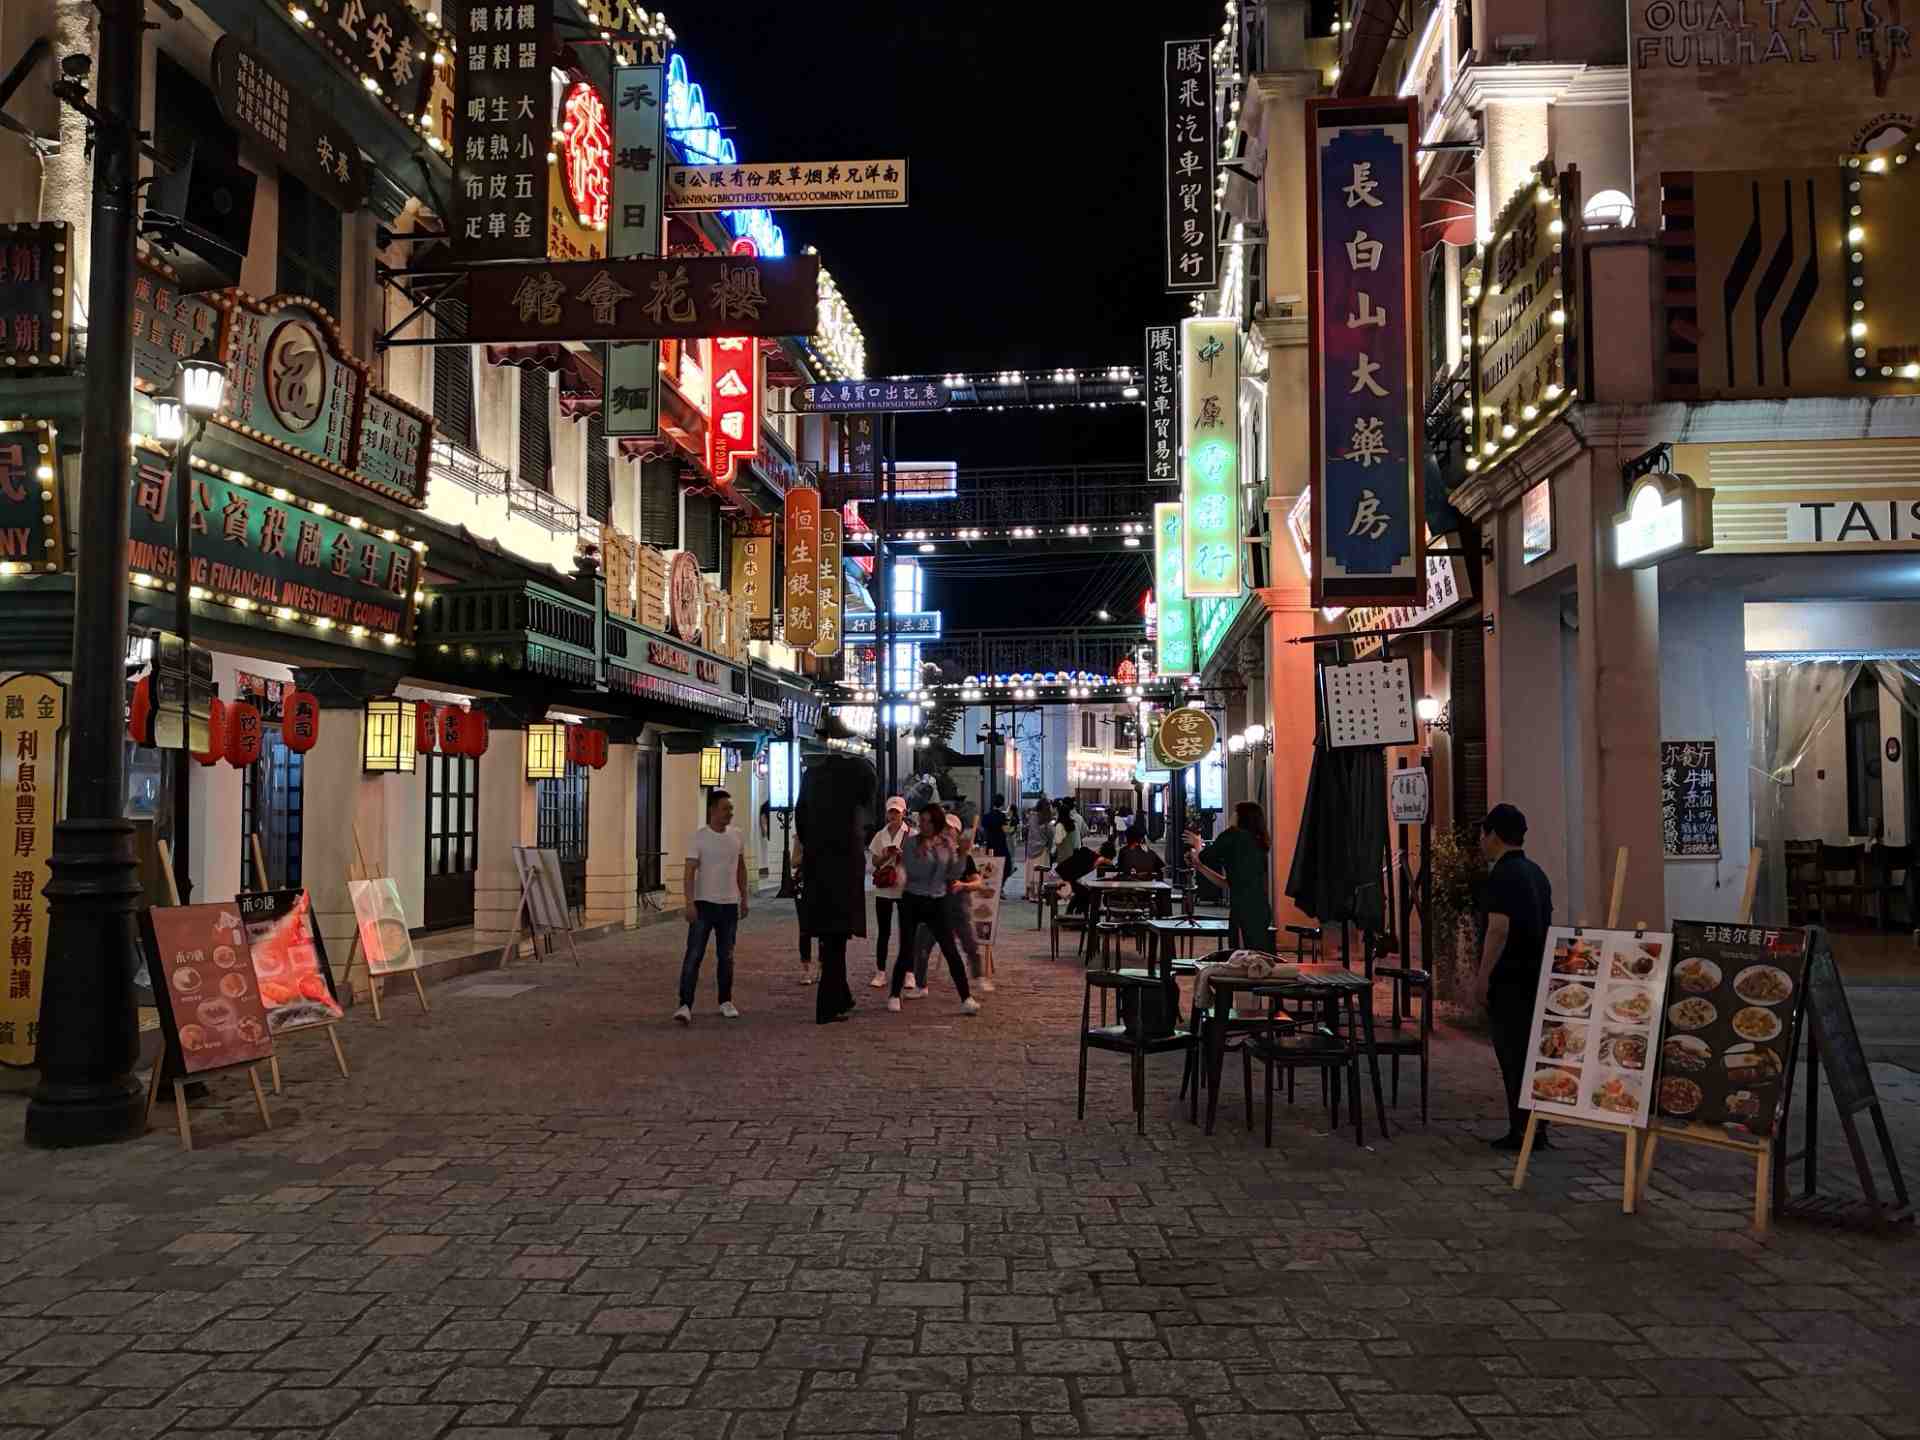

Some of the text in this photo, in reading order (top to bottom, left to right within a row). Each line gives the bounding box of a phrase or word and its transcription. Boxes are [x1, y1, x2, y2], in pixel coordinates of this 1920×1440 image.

[512, 95, 535, 238] 大小五金
[1175, 44, 1206, 277] 騰飛汽車貿易行
[1341, 162, 1391, 539] 長白山大藥房
[128, 538, 208, 584] MINSHNG
[210, 561, 278, 602] FINANCIAL
[282, 581, 351, 620] INVESTMENT
[788, 505, 816, 631] 恒生銀號
